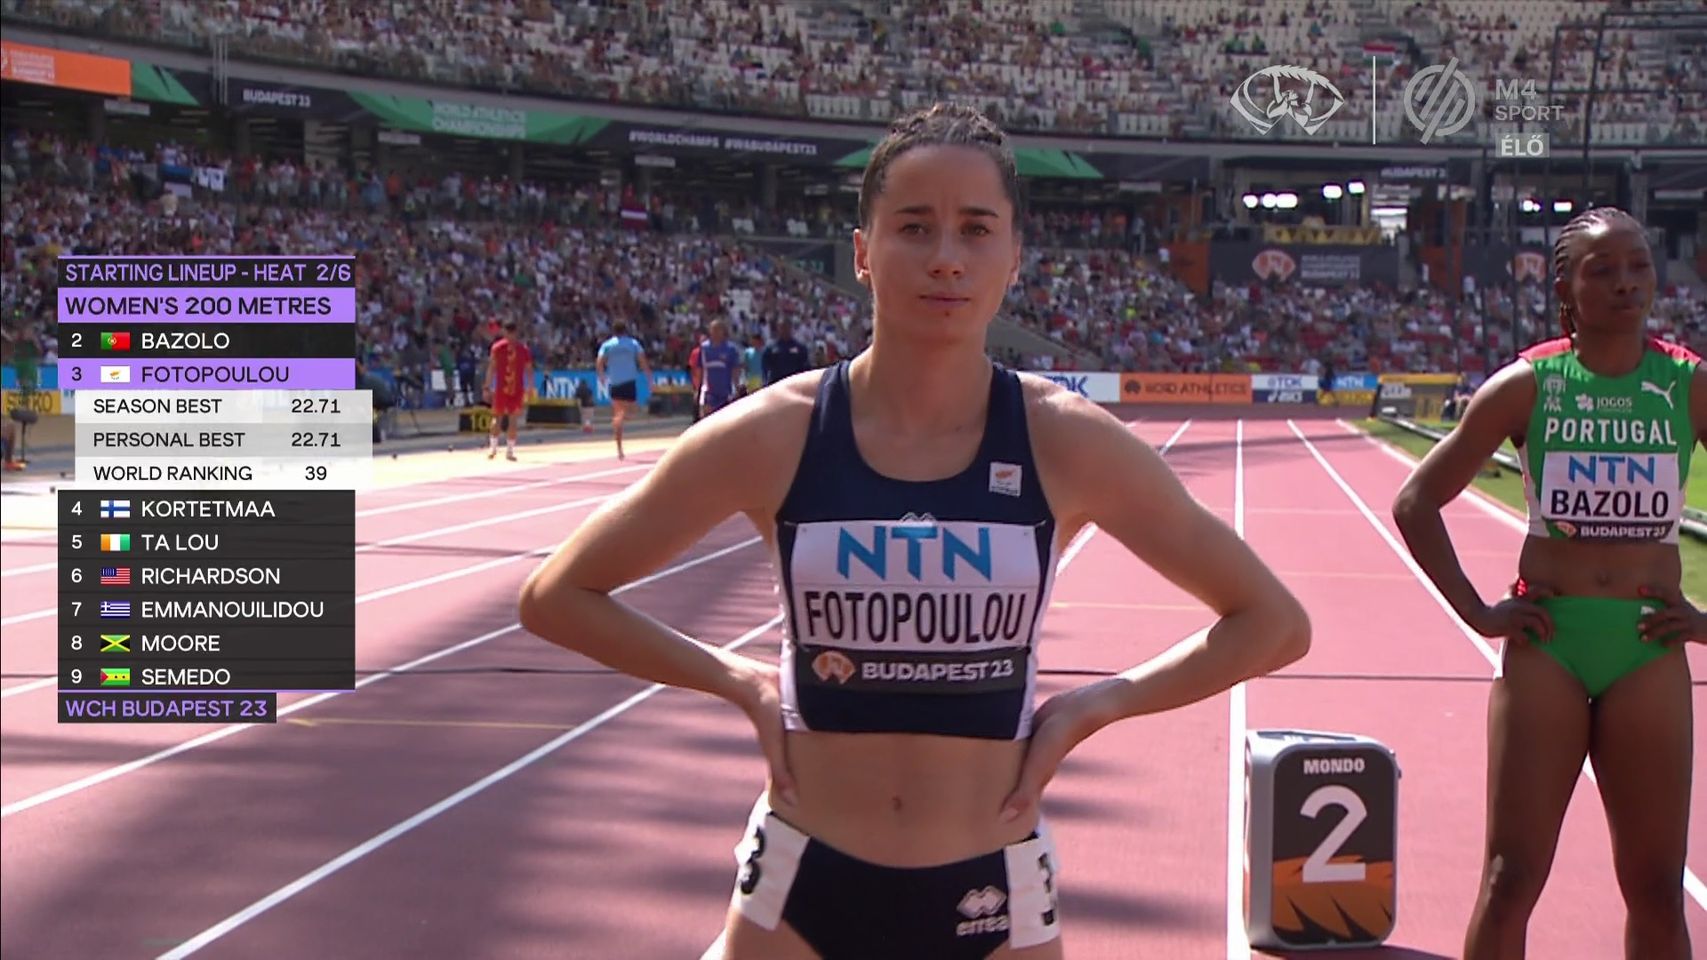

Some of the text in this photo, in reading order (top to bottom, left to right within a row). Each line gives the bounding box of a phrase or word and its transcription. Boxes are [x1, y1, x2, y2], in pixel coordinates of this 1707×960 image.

[1545, 418, 1677, 445] PORTUGAL
[1568, 455, 1655, 485] NTN
[1551, 489, 1669, 518] BAZOLO
[836, 525, 992, 582] NTN
[804, 591, 1026, 643] FOTOPOULOU
[1303, 758, 1366, 774] MONDO
[1299, 784, 1368, 884] 2
